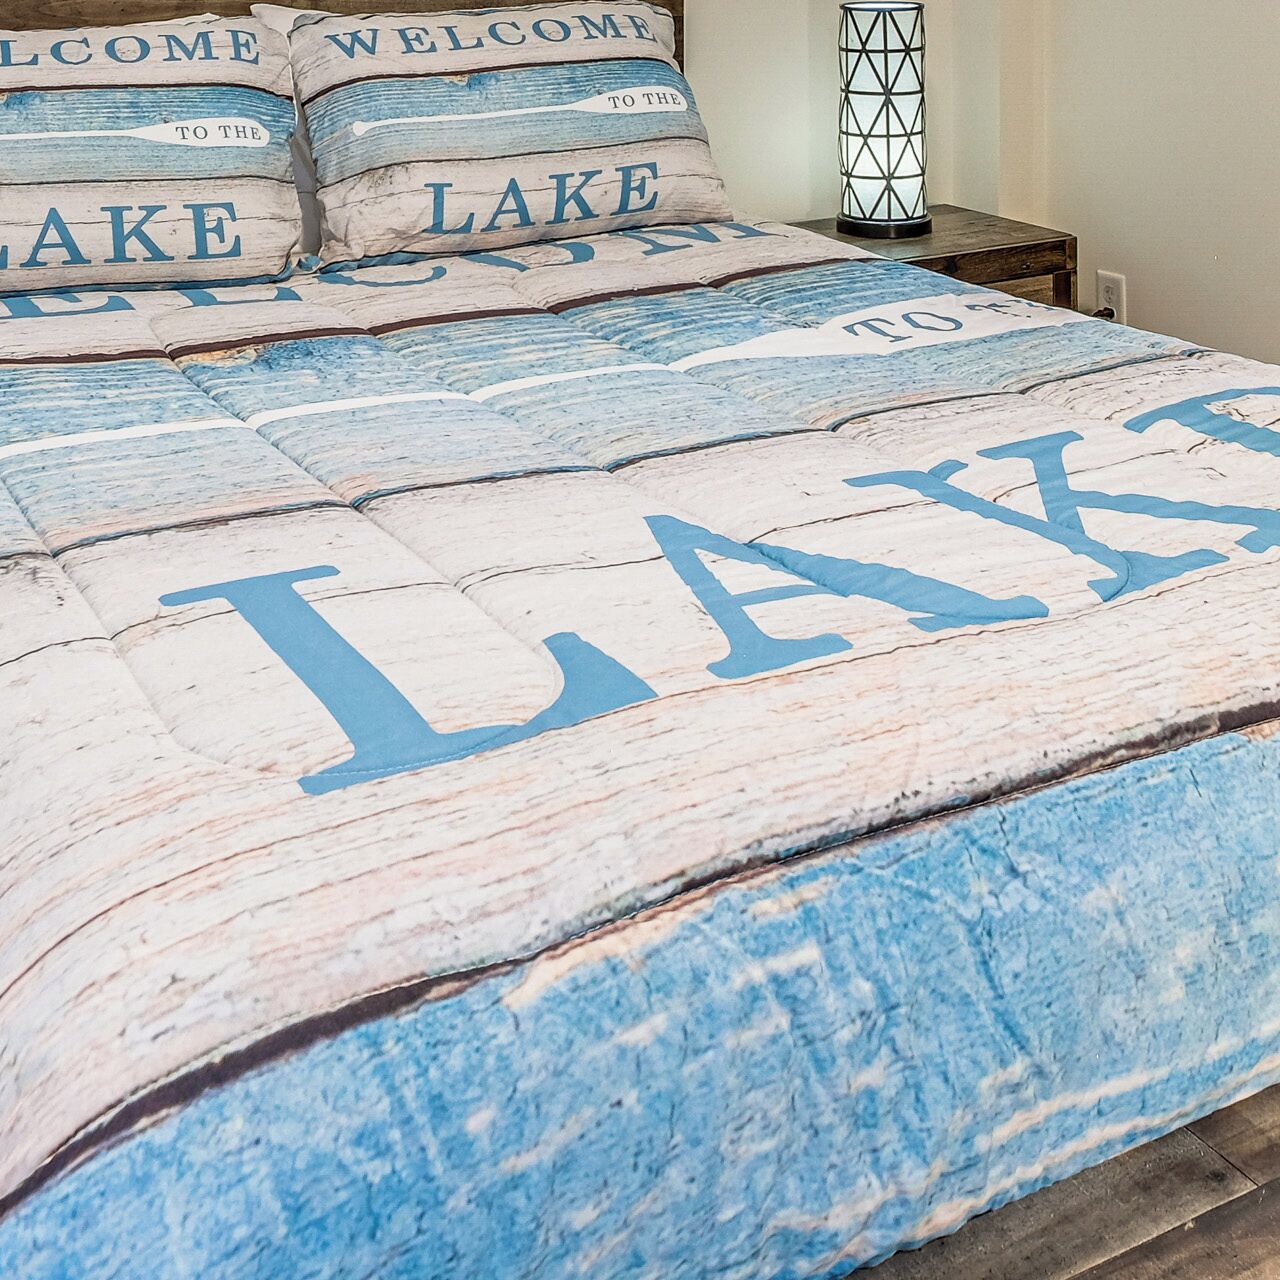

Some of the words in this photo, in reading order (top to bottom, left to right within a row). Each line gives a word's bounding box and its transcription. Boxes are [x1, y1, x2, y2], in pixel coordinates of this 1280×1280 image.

[326, 13, 658, 60] WELCOME
[608, 95, 636, 109] TO
[642, 90, 681, 107] THE
[175, 126, 207, 141] TO
[218, 124, 261, 141] THE
[422, 162, 660, 235] LAKE
[842, 311, 964, 344] TO
